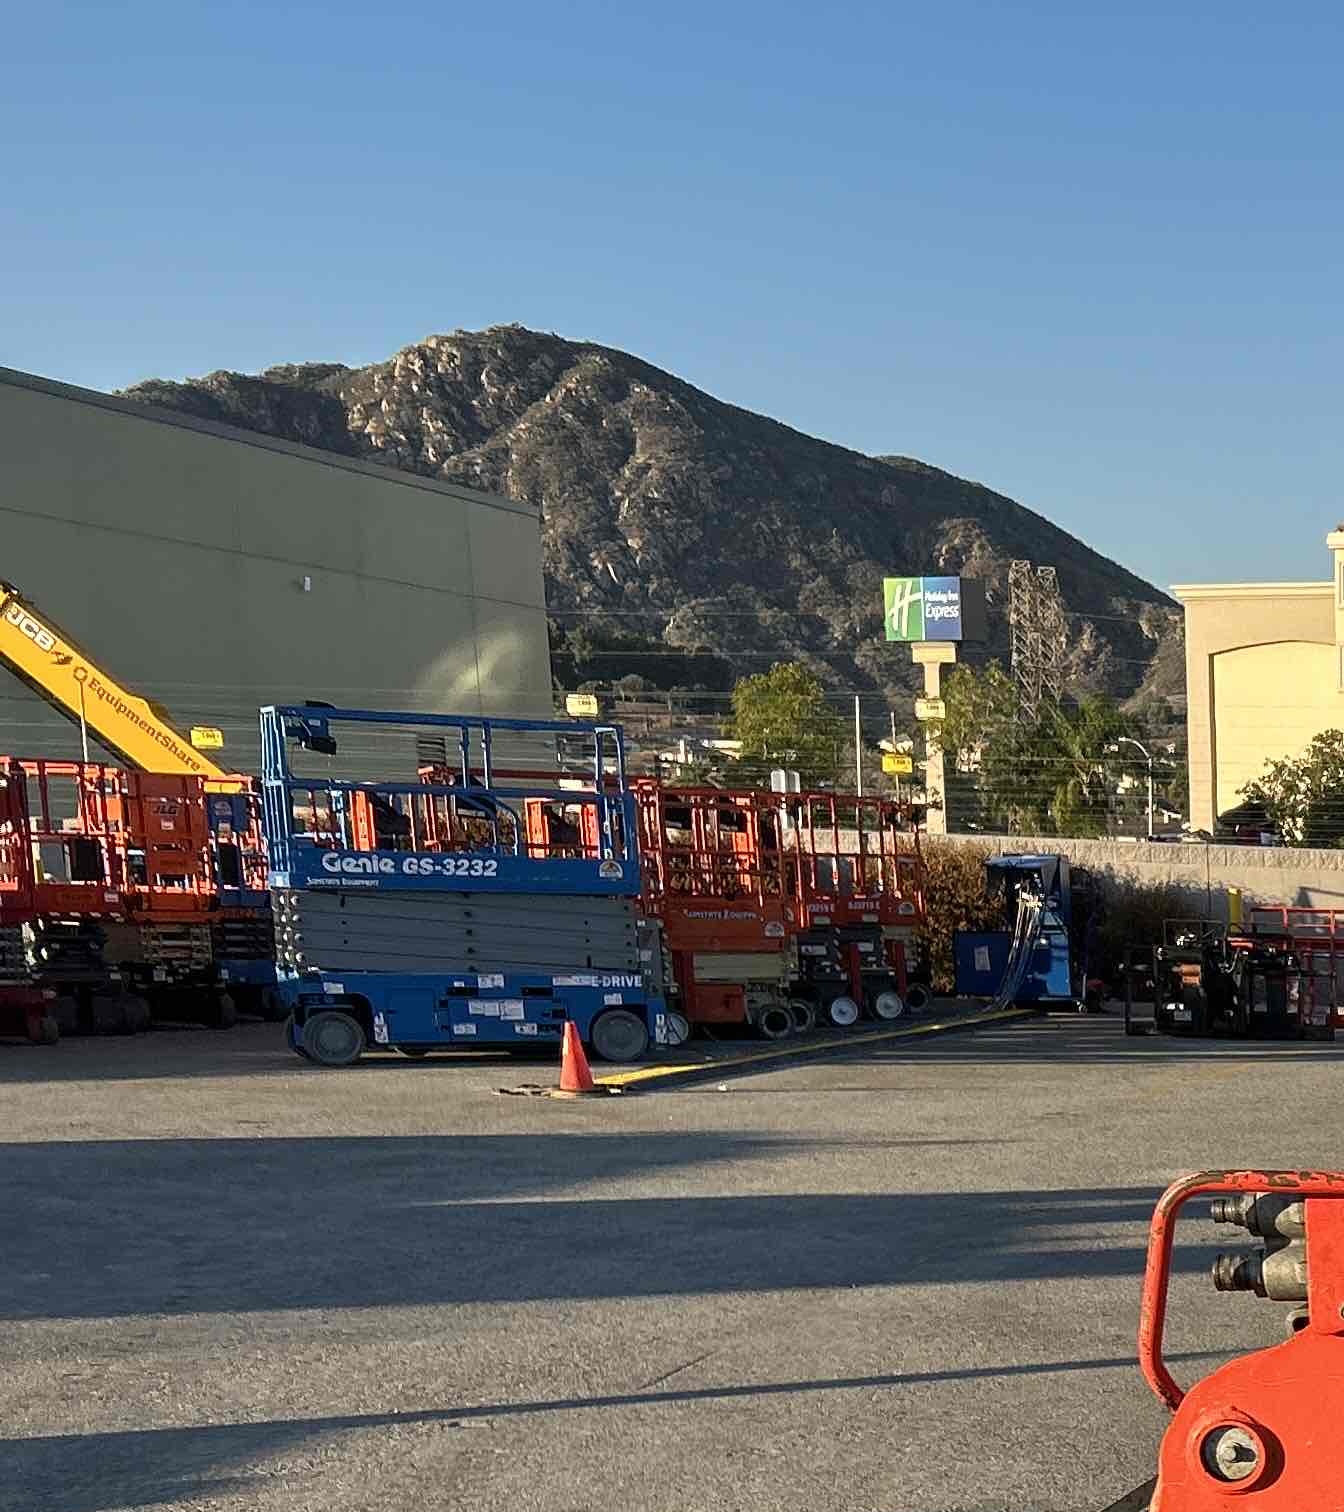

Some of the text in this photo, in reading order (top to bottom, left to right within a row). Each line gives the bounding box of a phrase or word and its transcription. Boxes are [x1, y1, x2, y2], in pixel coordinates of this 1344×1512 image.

[6, 604, 57, 653] JCB
[925, 603, 960, 621] Express
[87, 676, 202, 773] EquipmentShare
[321, 852, 498, 877] Genie GS-3232
